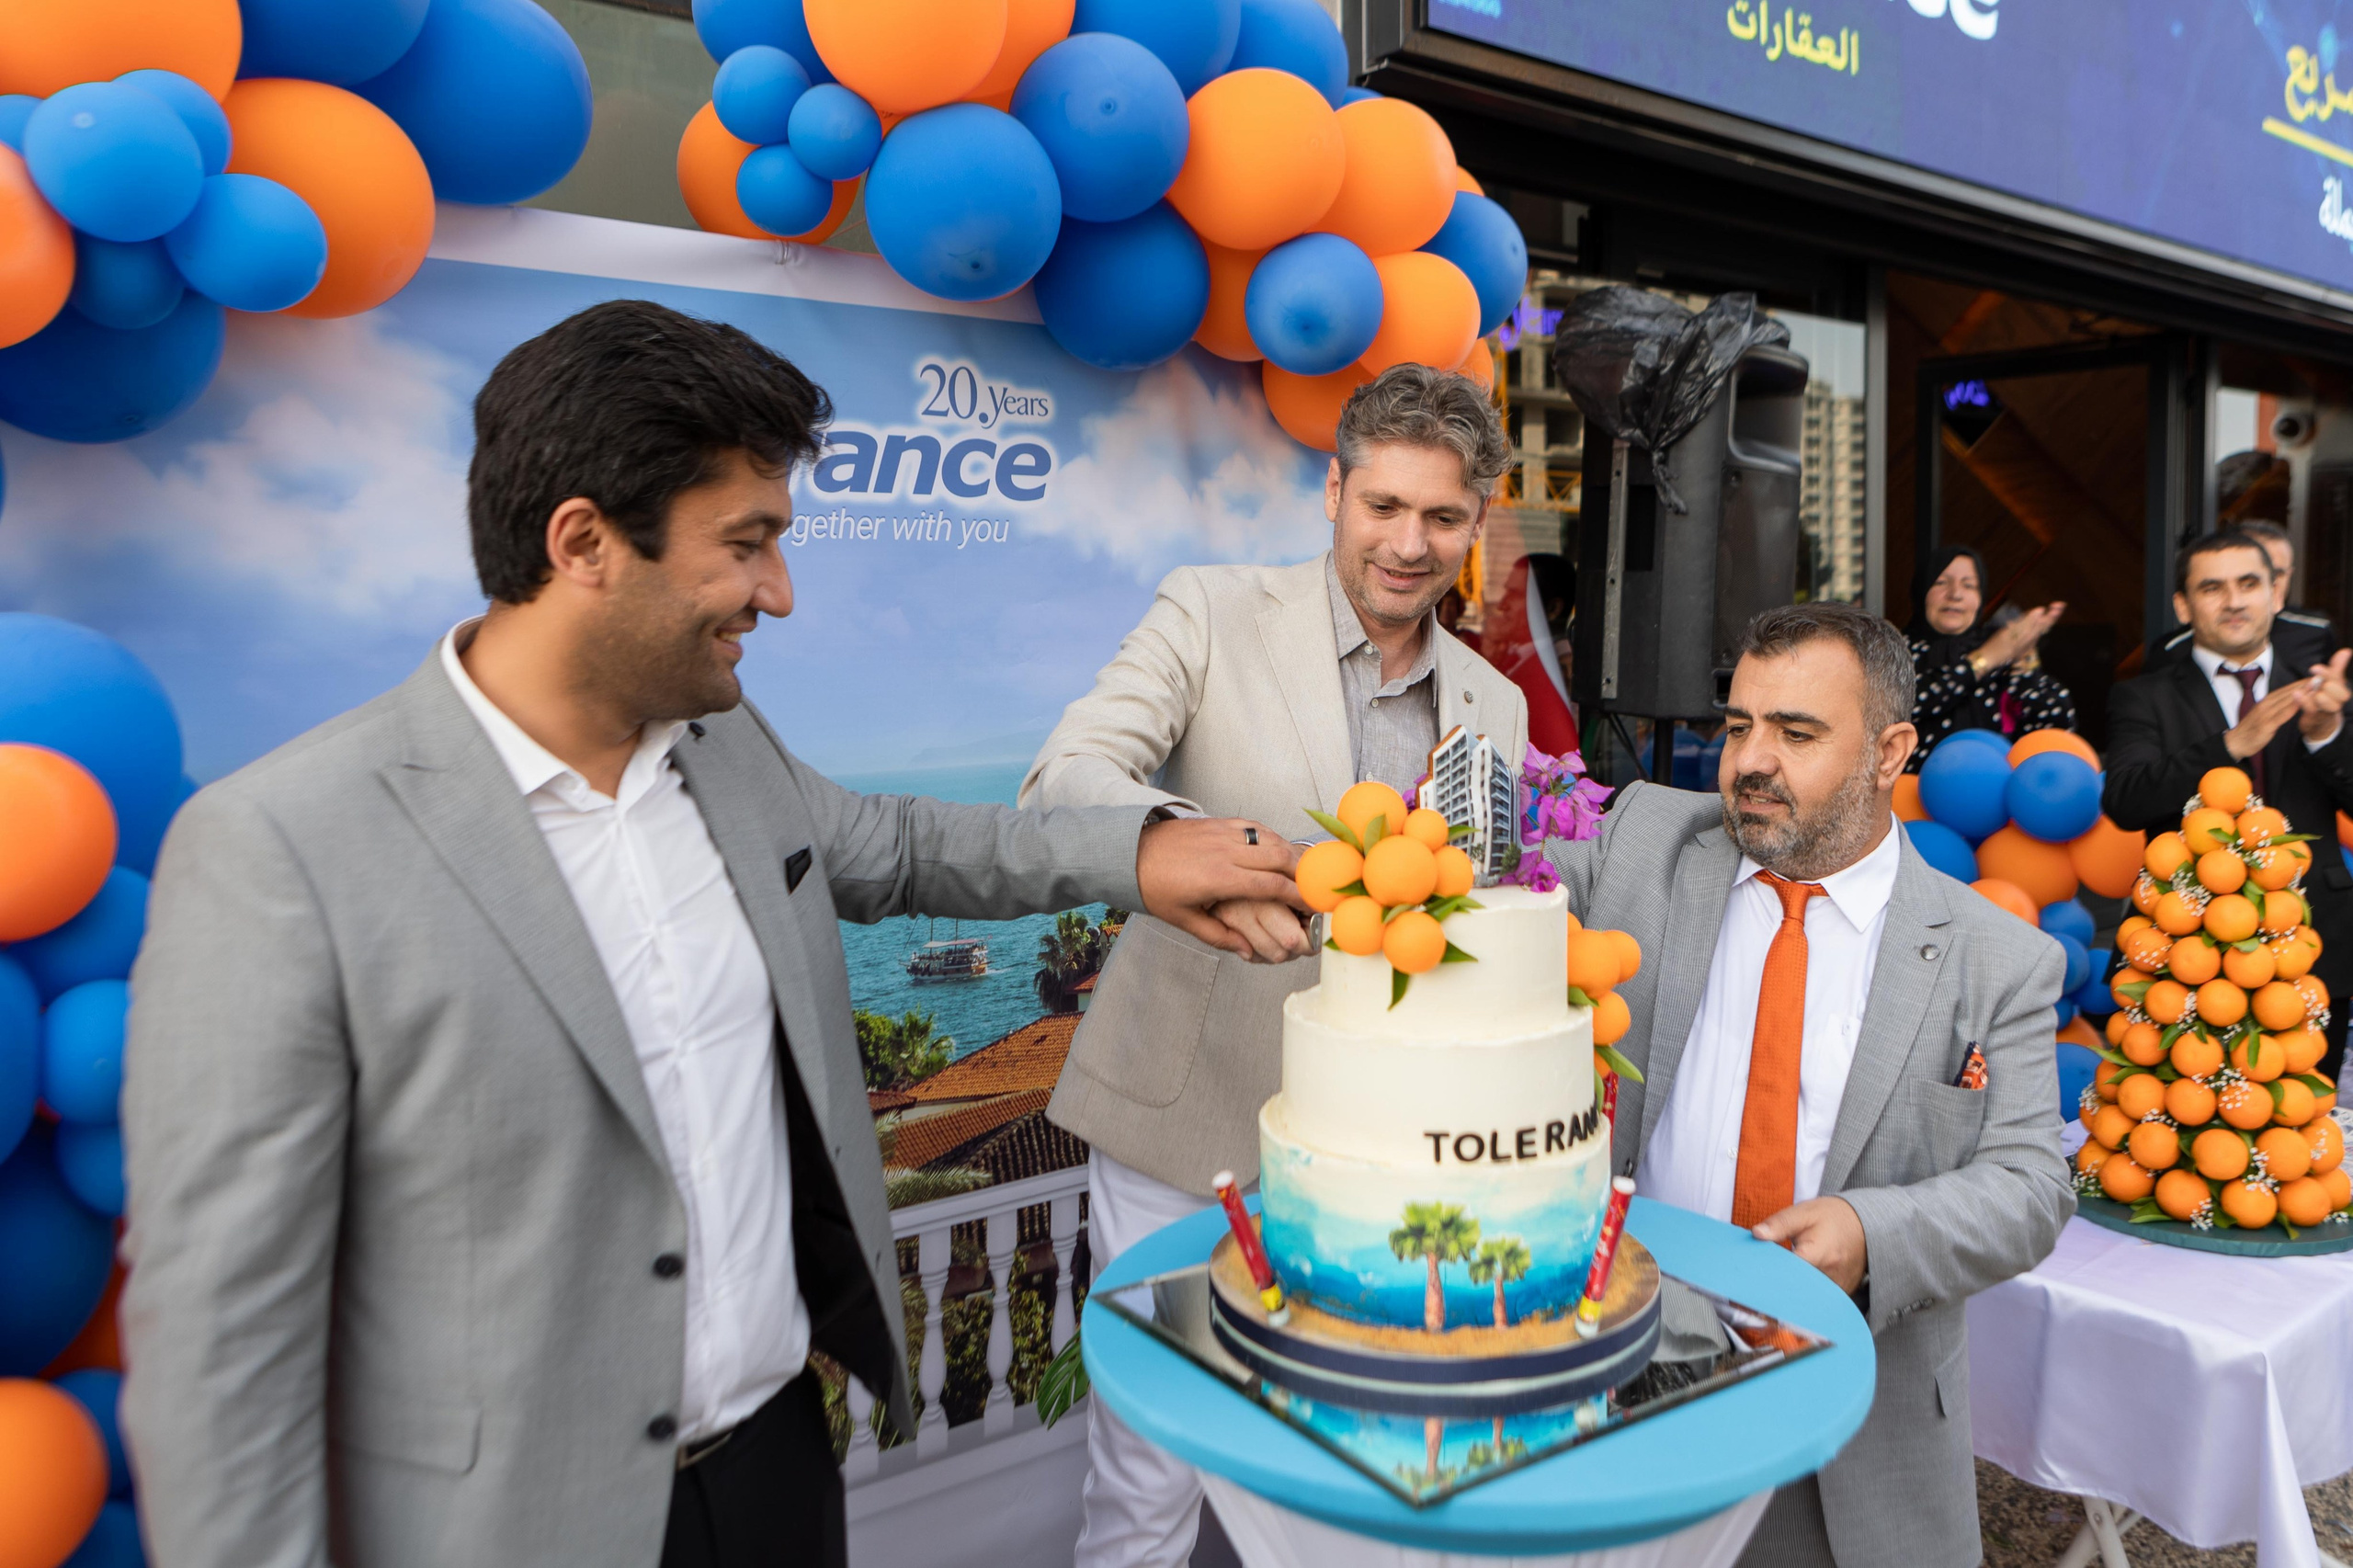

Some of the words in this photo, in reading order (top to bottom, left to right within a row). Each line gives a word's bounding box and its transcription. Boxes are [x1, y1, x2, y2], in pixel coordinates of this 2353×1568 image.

[792, 431, 1051, 501] ance
[780, 507, 885, 546] gether
[893, 511, 951, 541] with
[958, 516, 1009, 550] you
[1424, 1095, 1598, 1163] TOLERAN
